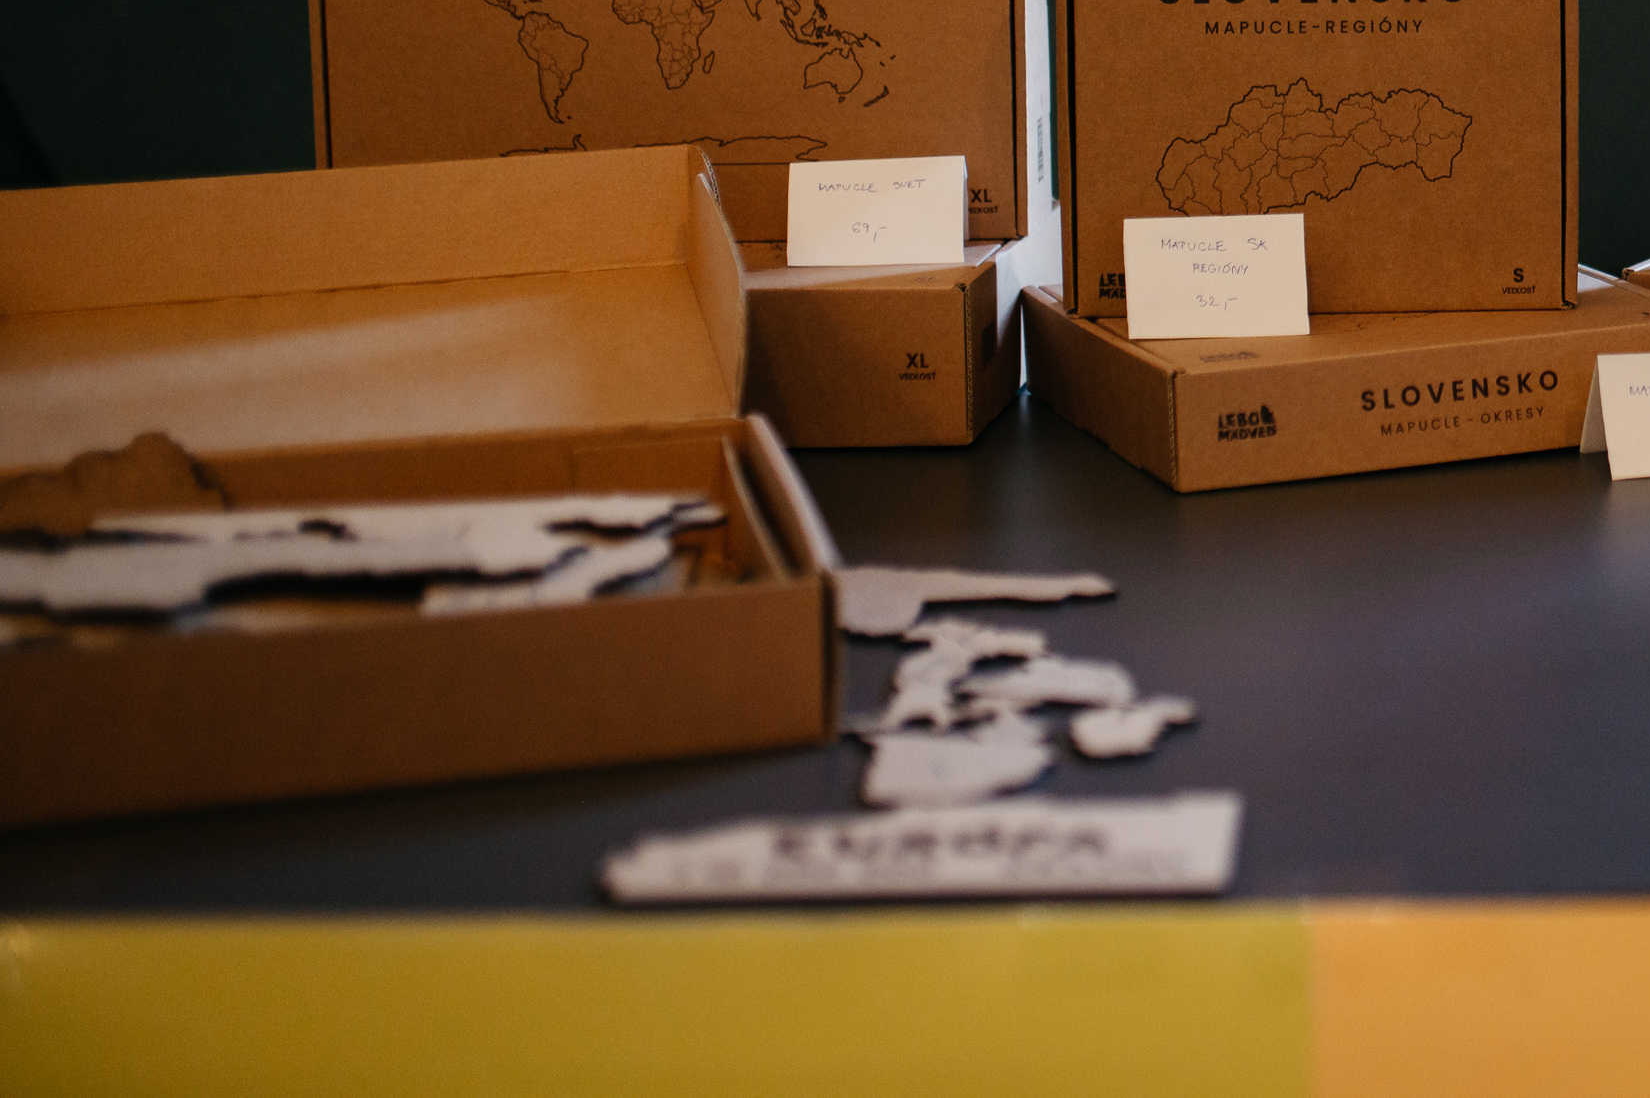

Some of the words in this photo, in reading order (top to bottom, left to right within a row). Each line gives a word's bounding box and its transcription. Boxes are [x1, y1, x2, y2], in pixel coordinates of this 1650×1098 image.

[971, 188, 992, 203] XL
[1161, 238, 1227, 252] MAPUCLE
[1247, 237, 1268, 251] SK
[1512, 267, 1525, 283] S
[906, 353, 929, 368] XL
[1361, 370, 1558, 412] SLOVENSKO
[1218, 411, 1260, 429] LEBO
[1381, 416, 1460, 436] MAPUCLE
[1481, 406, 1544, 425] OKRESY
